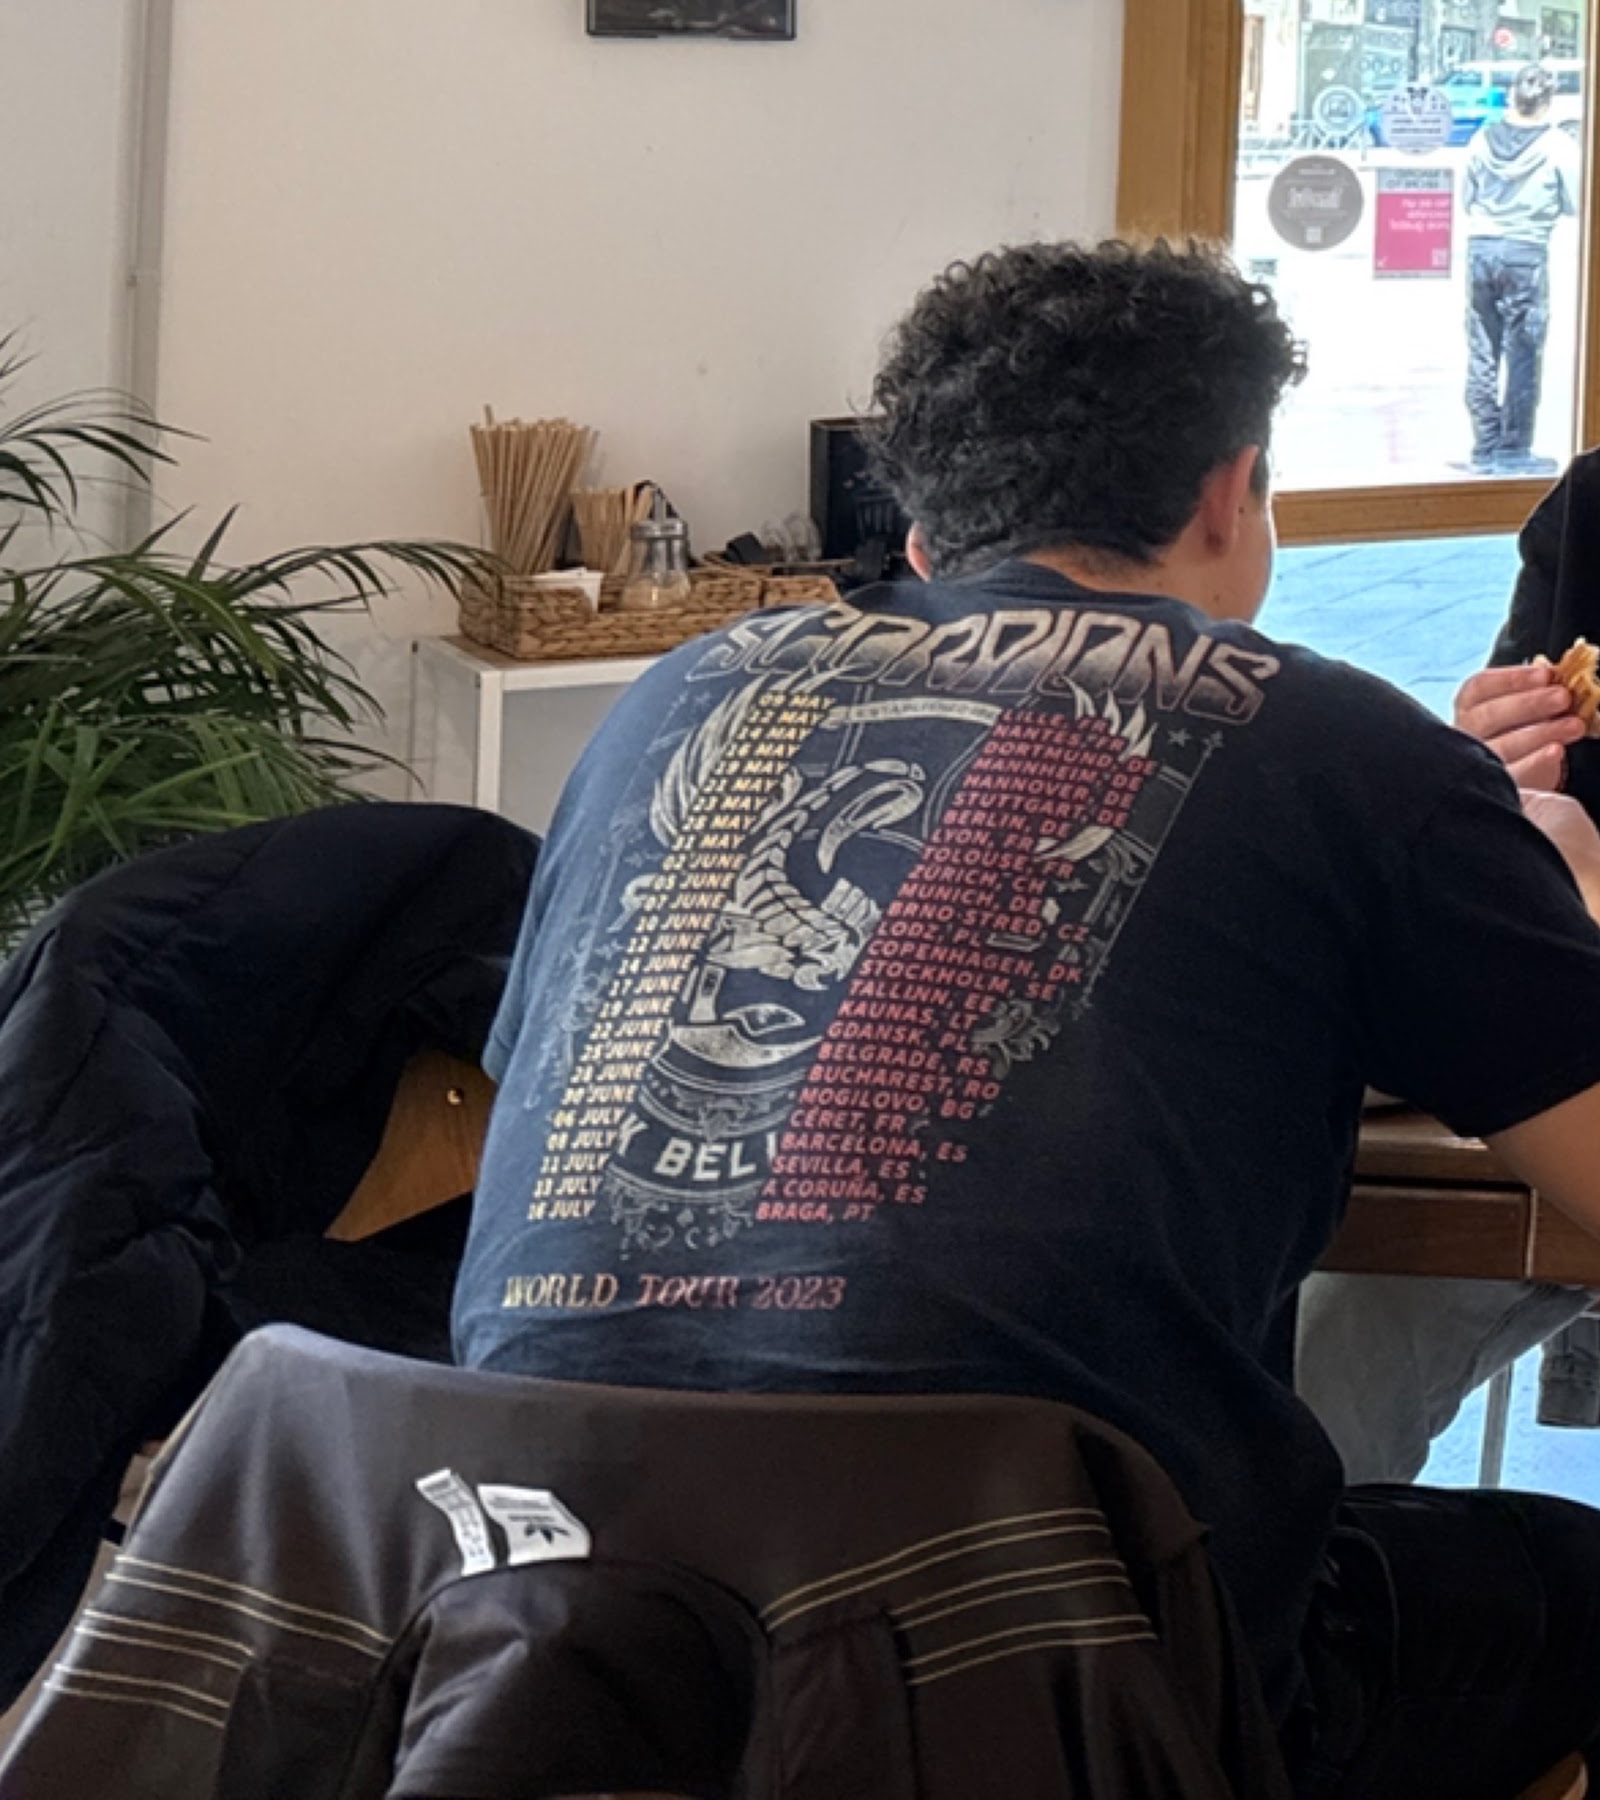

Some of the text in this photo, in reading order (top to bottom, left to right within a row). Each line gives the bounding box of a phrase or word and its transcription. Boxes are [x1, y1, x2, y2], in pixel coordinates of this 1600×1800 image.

[685, 602, 1281, 726] SCORPIONS
[758, 694, 836, 709] 09 MAY
[778, 710, 823, 724] MAY
[1000, 708, 1070, 728] LILLE,
[1077, 716, 1109, 732] FR
[766, 726, 813, 741] MAY
[992, 725, 1127, 750] NANTES, FR
[754, 743, 800, 757] MAY
[982, 741, 1157, 774] DORTMUND, DE
[743, 760, 789, 775] MAY
[971, 757, 1143, 791] MANNHEIM, DE
[731, 778, 778, 792] MAY
[962, 774, 1135, 808] HANNOVER, DE
[720, 795, 768, 810] MAY
[951, 791, 1129, 828] STUTTGART, DE
[710, 814, 757, 830] MAY
[943, 810, 1073, 838] BERLIN, DE
[700, 833, 746, 848] MAY
[931, 828, 1034, 852] LYON, FR
[690, 853, 747, 869] JUNE
[1042, 861, 1075, 878] FR
[679, 872, 736, 888] JUNE
[1011, 877, 1046, 894] CH
[669, 892, 726, 909] JUNE
[899, 882, 1042, 915] MUNICH, DE
[660, 913, 716, 930] JUNE
[652, 933, 706, 950] JUNE
[953, 930, 981, 947] PL
[1058, 924, 1089, 943] CZ
[643, 954, 696, 972] JUNE
[867, 940, 1083, 983] COPENHAGEN, DK
[633, 975, 685, 993] JUNE
[859, 959, 1057, 1000] STOCKHOLM, SE
[624, 996, 674, 1015] JUNE
[849, 979, 995, 1013] TALLINN, EE
[838, 999, 981, 1030] KAUNAS, LT
[613, 1019, 665, 1037] JUNE
[604, 1041, 656, 1059] JUNE
[939, 1033, 969, 1052] PL
[818, 1042, 990, 1076] BELGRADE, RS
[596, 1063, 647, 1081] JUNE
[808, 1063, 999, 1099] BUCHAREST, RO
[586, 1084, 637, 1103] JUNE
[799, 1087, 975, 1120] MOGILOVO, BG
[578, 1106, 625, 1126] JULY
[874, 1114, 907, 1132] FR
[571, 1129, 618, 1149] JULY
[781, 1132, 968, 1162] BARCELONA, ES
[562, 1153, 610, 1171] JULY
[772, 1155, 911, 1179] SEVILLA, ES
[555, 1175, 602, 1195] JULY
[894, 1184, 928, 1203] ES
[548, 1200, 595, 1218] JULY
[755, 1203, 876, 1224] BRAGA, PT
[502, 1273, 847, 1309] WORLD TOUR 2023
